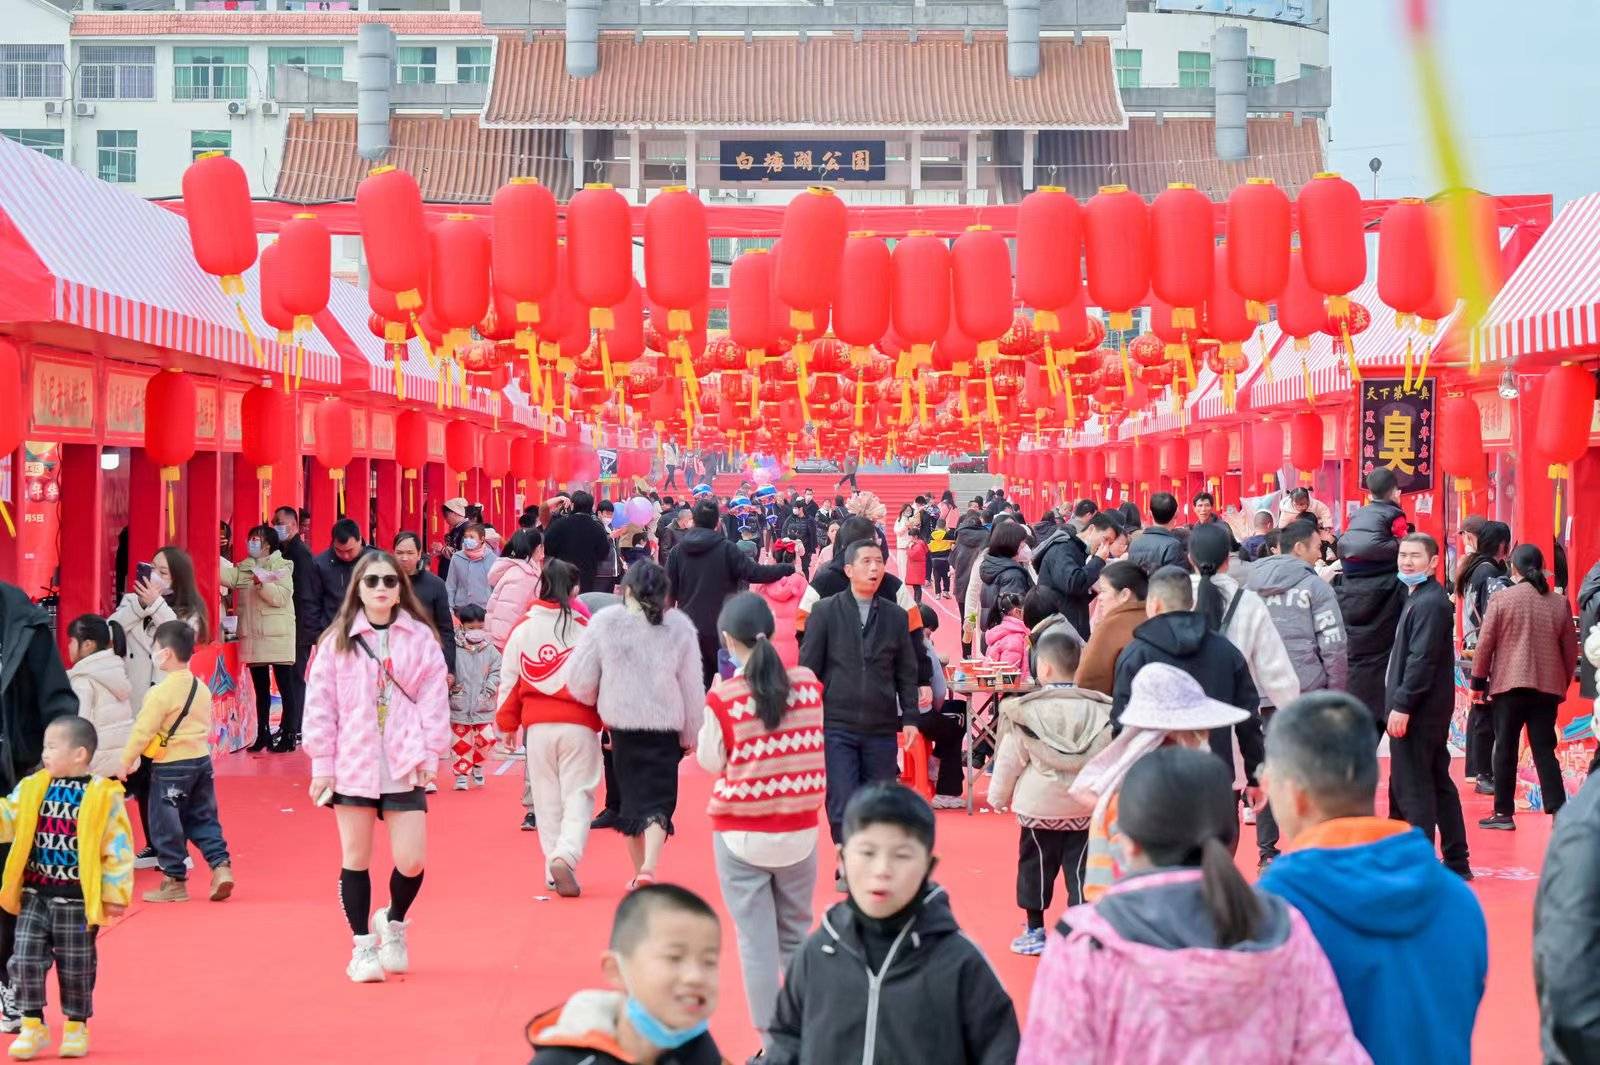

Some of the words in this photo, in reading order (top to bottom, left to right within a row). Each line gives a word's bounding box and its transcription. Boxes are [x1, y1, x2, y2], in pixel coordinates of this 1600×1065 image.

[1366, 385, 1430, 401] 天下第一臭
[1379, 410, 1415, 476] 臭
